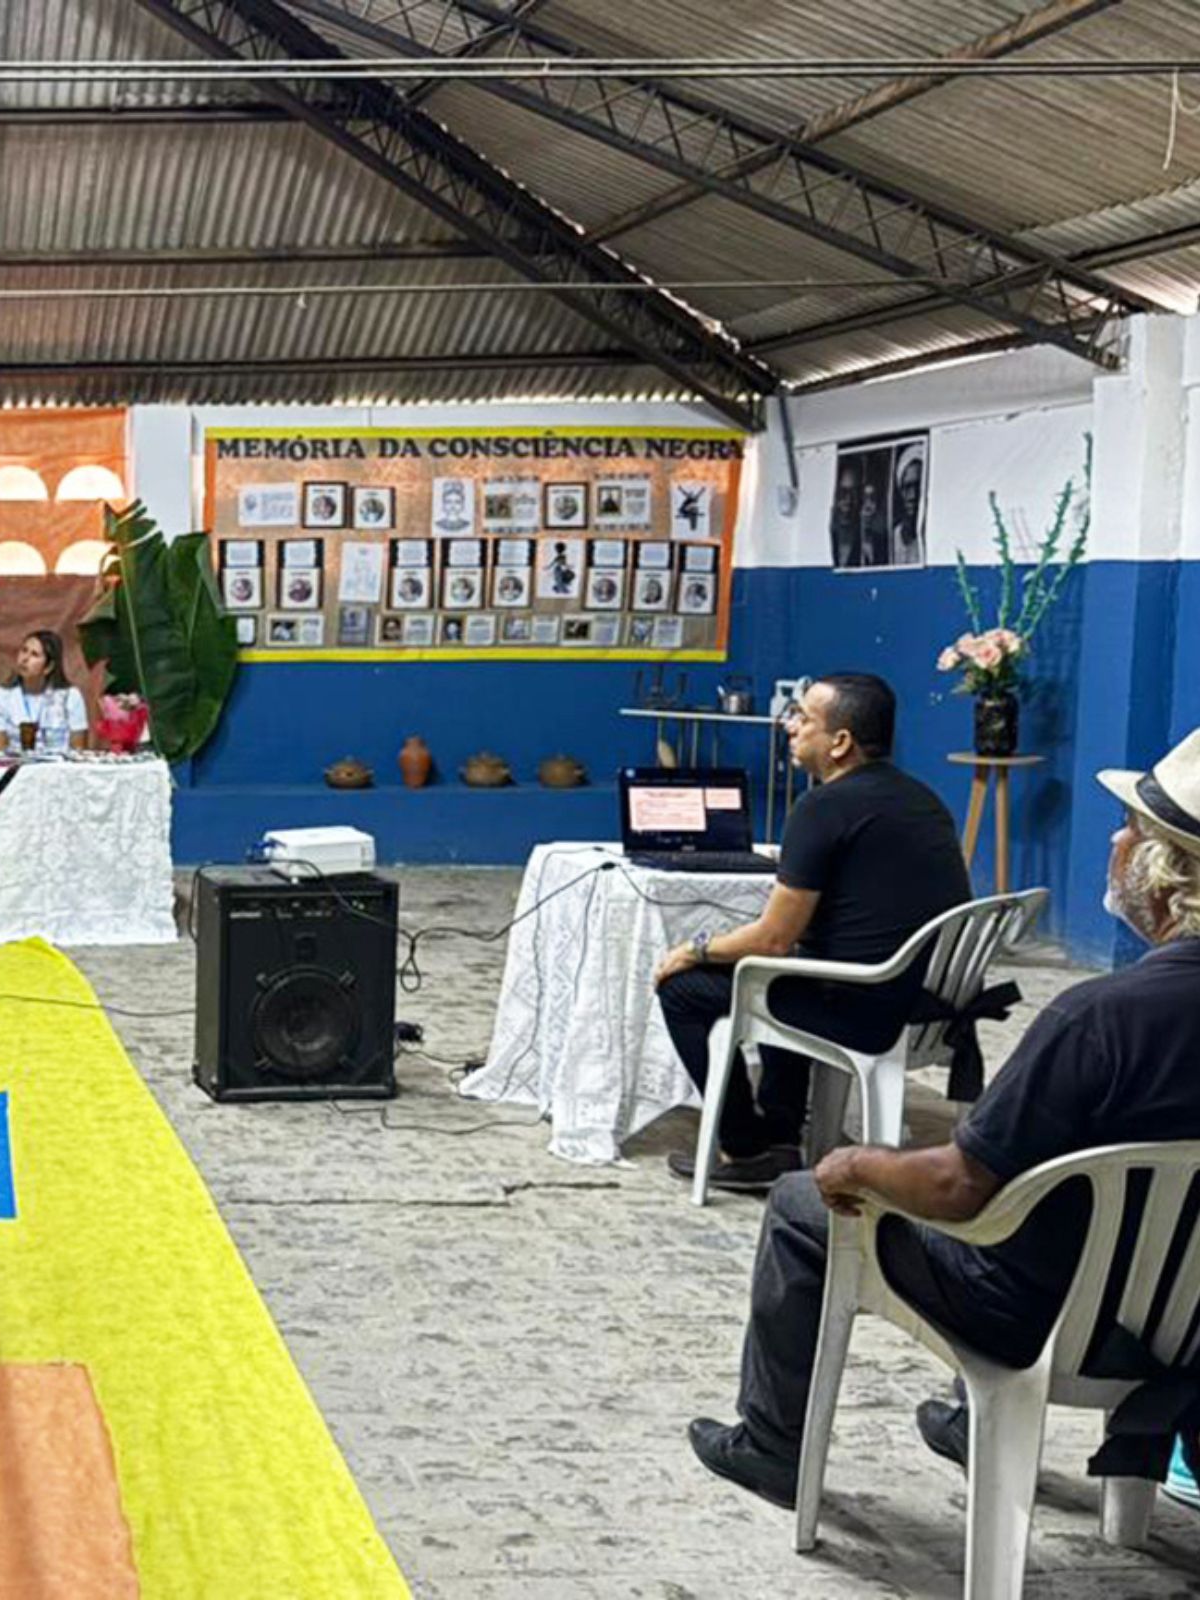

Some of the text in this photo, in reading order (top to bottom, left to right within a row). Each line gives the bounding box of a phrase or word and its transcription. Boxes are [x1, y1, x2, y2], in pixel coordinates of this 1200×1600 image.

[216, 430, 745, 461] MEMÓRIA DA CONSCIÊNCIA NEGRA
